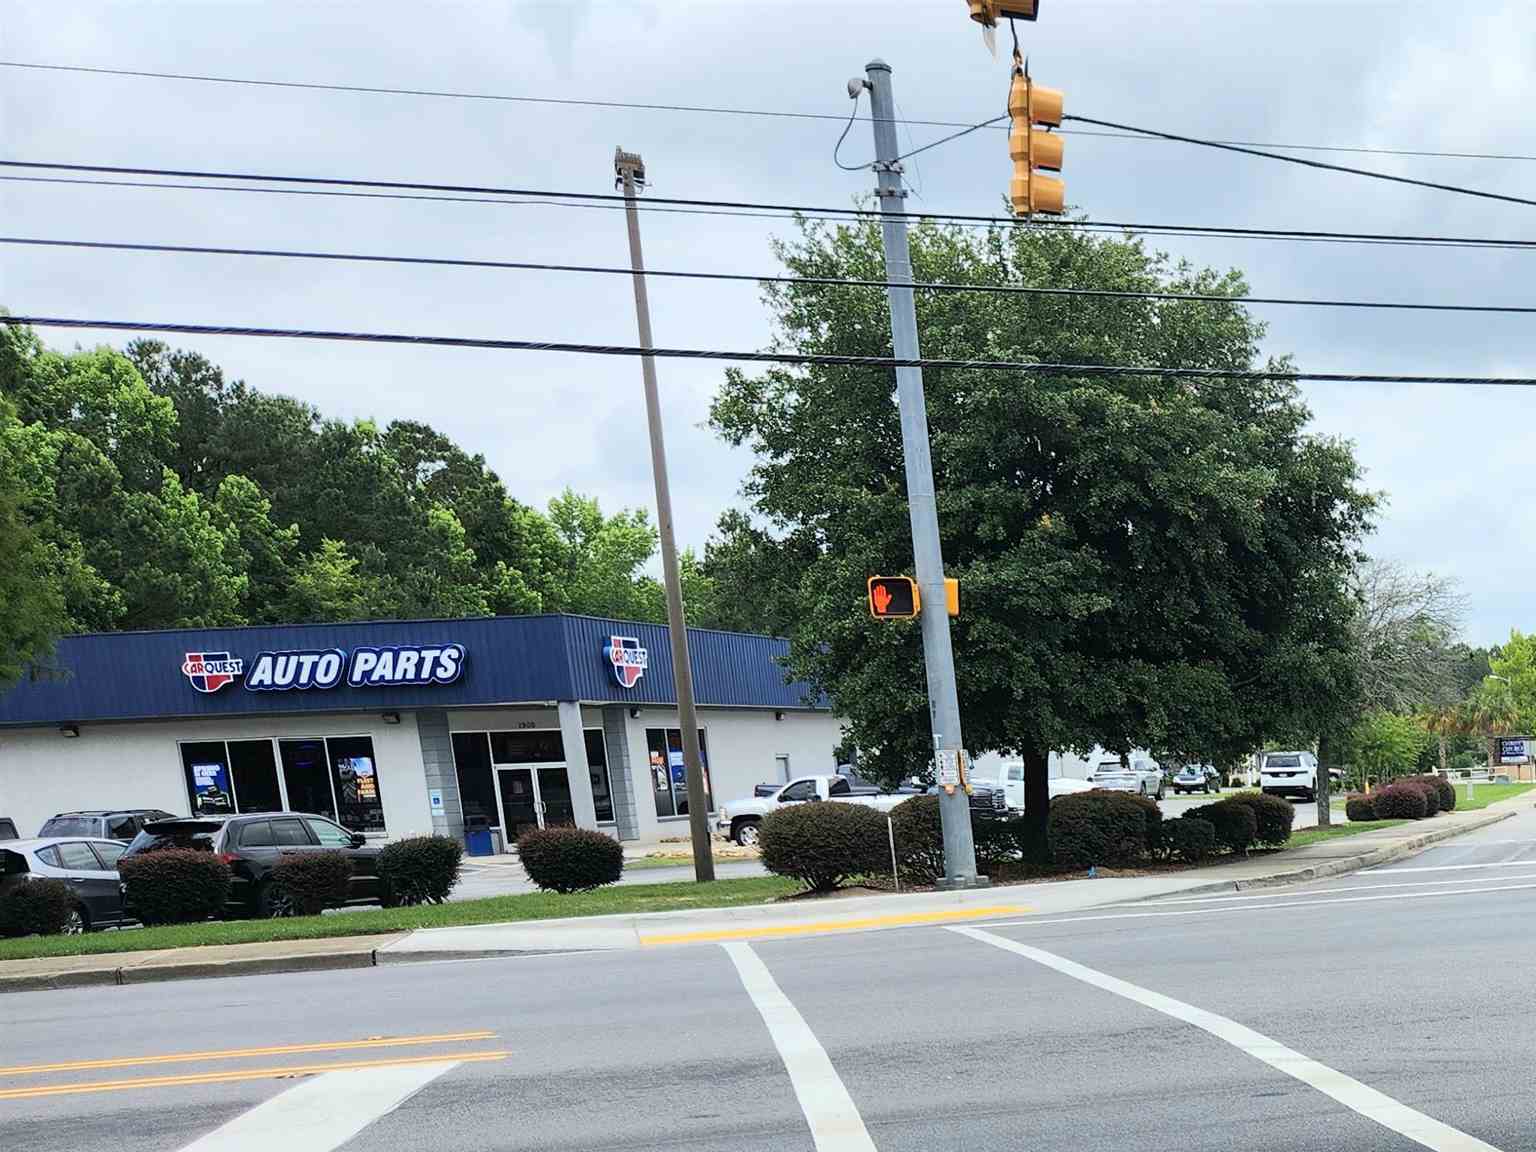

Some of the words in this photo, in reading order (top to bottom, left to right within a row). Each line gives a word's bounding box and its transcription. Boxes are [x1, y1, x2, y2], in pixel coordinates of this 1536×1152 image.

[183, 661, 241, 674] CARQUEST
[249, 653, 341, 685] AUTO
[352, 648, 460, 682] PARTS
